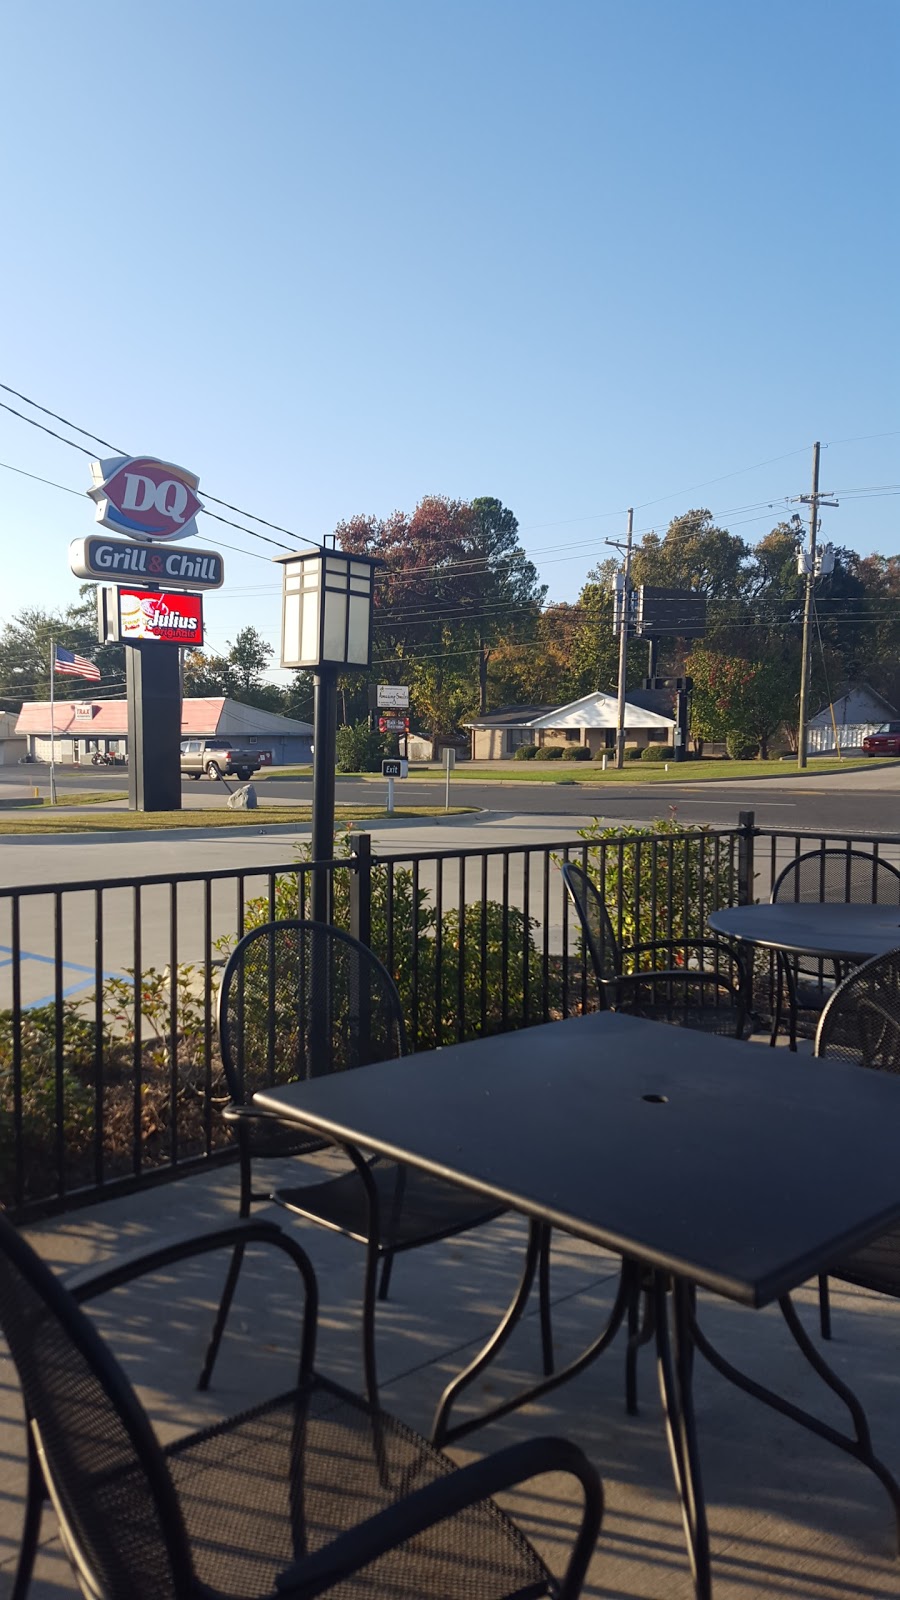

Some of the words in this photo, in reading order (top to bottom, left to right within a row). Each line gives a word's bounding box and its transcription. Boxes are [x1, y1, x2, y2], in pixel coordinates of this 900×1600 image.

[121, 473, 187, 523] DQ
[95, 545, 146, 572] Grill
[148, 555, 163, 573] &
[165, 554, 216, 580] Chill
[148, 610, 197, 628] Julius
[386, 765, 398, 774] Exit
